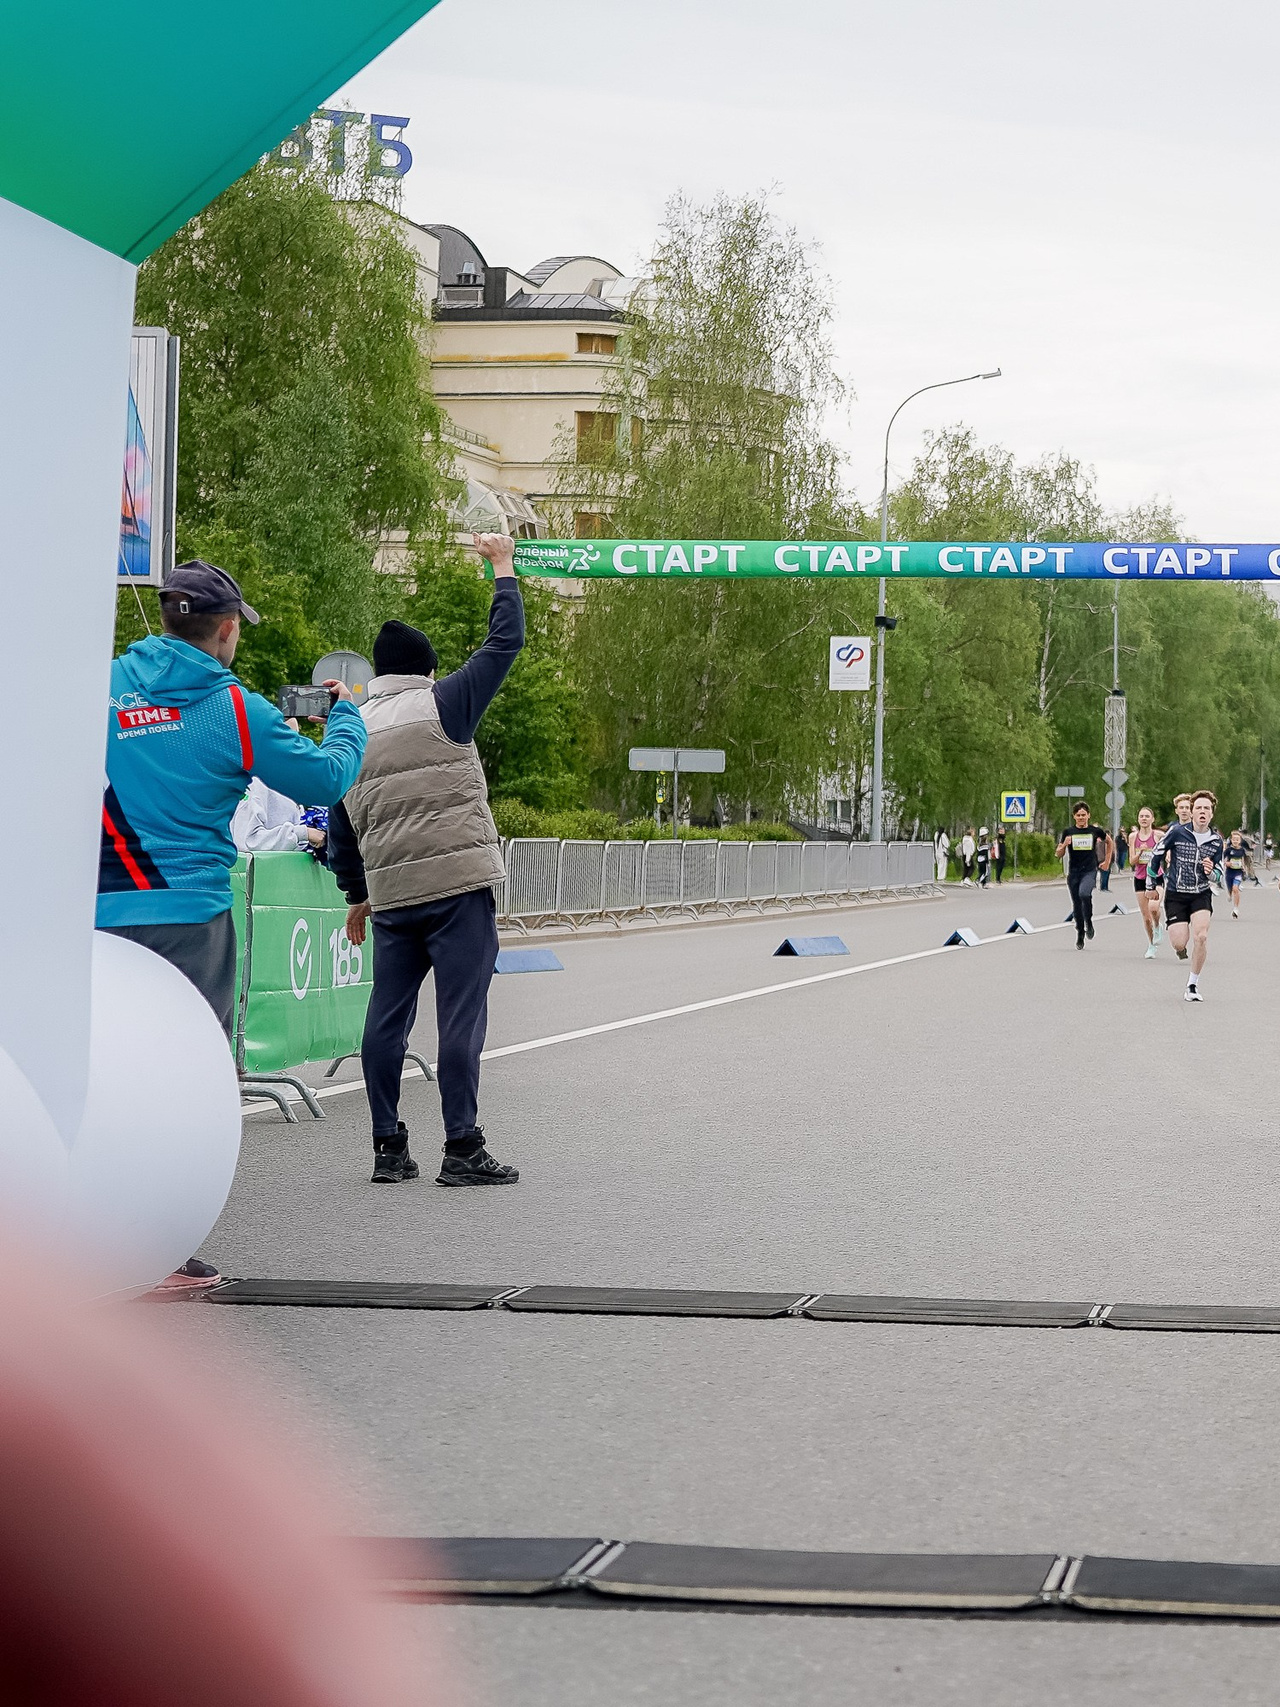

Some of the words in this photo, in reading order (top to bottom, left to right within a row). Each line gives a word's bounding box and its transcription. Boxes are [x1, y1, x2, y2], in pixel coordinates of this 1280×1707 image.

[515, 545, 569, 558] елёный
[612, 544, 746, 574] СТАРТ
[773, 545, 909, 573] СТАРТ
[938, 546, 1073, 574] СТАРТ
[1103, 547, 1239, 576] СТАРТ
[513, 556, 565, 570] арафон
[109, 692, 149, 710] ACE
[125, 707, 172, 726] TIME
[117, 728, 147, 740] ВРЕМЯ
[329, 926, 363, 986] 185
